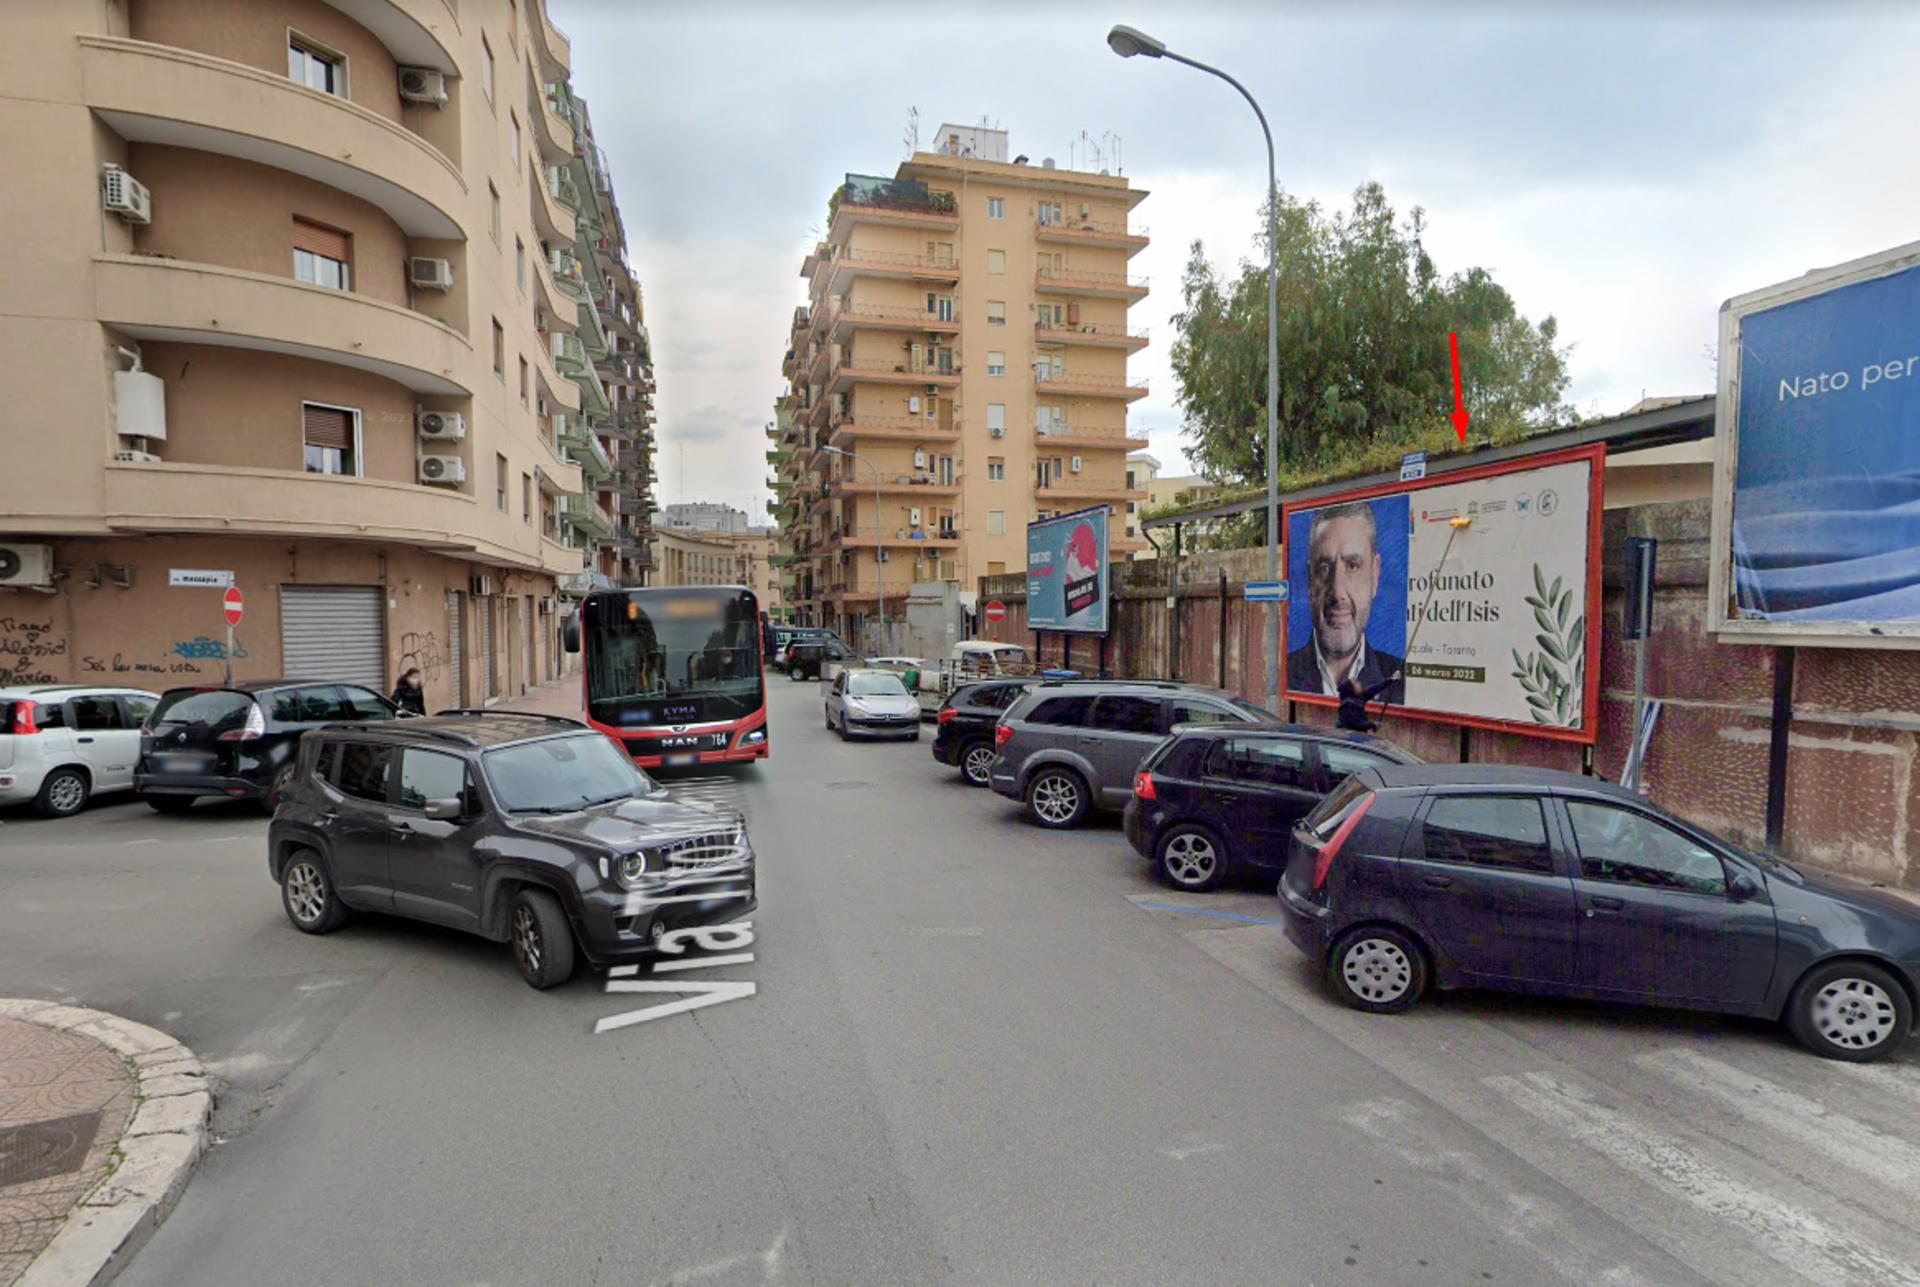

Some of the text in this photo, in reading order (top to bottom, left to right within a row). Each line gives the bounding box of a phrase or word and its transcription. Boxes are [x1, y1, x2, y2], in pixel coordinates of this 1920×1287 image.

[1779, 356, 1919, 401] Nato per
[1407, 568, 1494, 592] rofanato
[1453, 669, 1475, 679] 2022
[663, 705, 697, 716] KYMA
[661, 737, 698, 747] MAN
